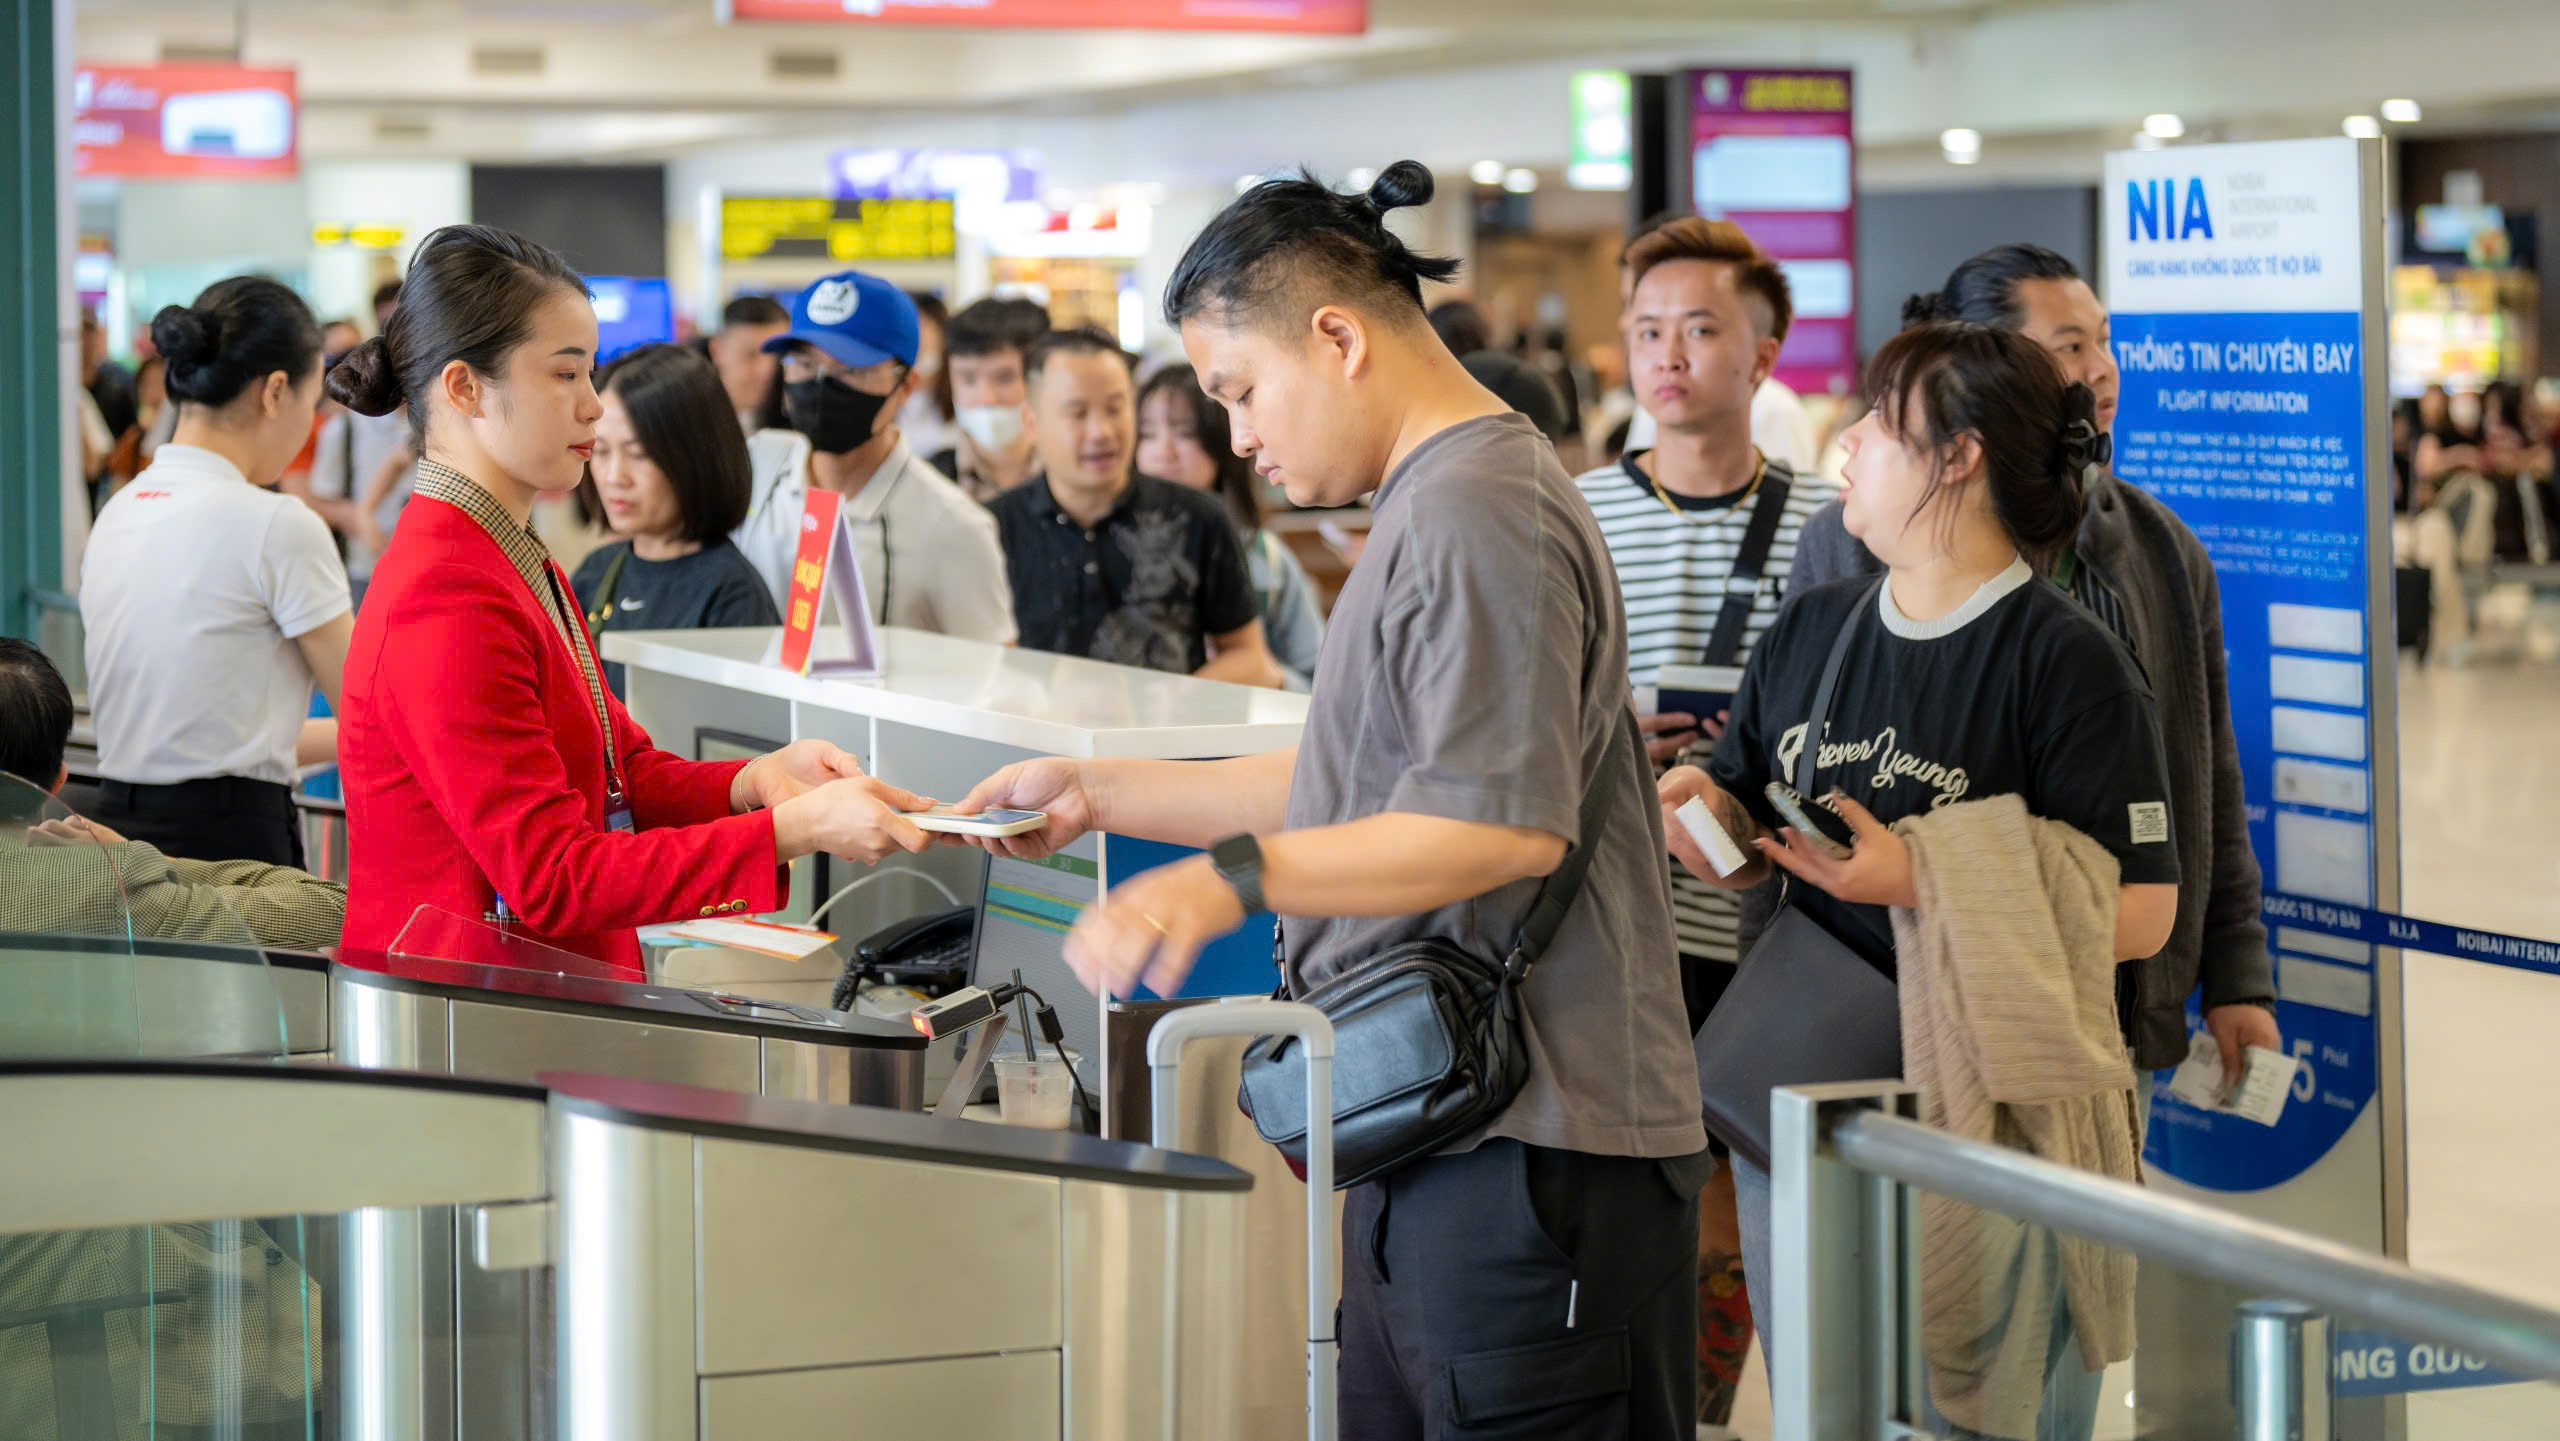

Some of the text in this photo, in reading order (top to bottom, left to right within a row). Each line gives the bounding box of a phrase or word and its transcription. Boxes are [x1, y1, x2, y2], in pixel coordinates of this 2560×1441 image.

[2127, 176, 2213, 240] NIA
[2117, 334, 2186, 372] THÔNG
[2190, 341, 2221, 371] TIN
[2312, 342, 2355, 374] BAY
[2157, 388, 2309, 414] FLIGHT INFORMATION
[1871, 726, 1970, 809] Young
[2456, 931, 2503, 955] NOIBAI
[2293, 1037, 2316, 1104] 5
[2333, 1347, 2396, 1382] NG
